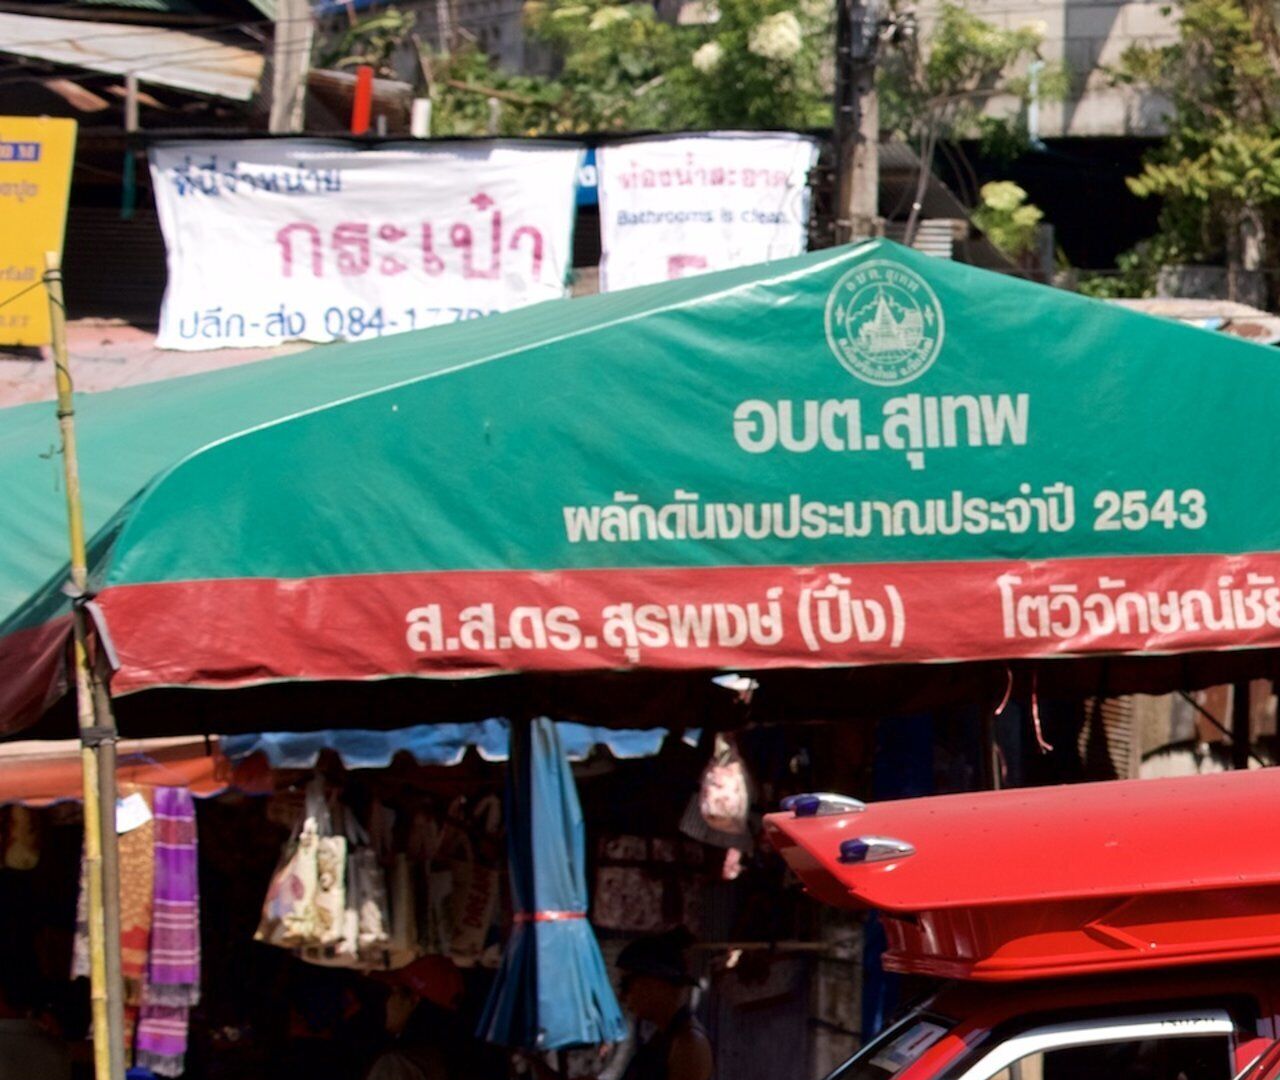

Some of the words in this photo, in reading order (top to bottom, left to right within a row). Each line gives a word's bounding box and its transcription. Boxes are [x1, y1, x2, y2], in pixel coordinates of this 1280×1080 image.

[276, 192, 545, 282] กระเป๋า
[617, 209, 712, 226] Bathrooms
[734, 393, 1029, 469] อบต.สุเทพ
[563, 484, 1074, 544] ผลักดันงบประมาณประจำปี
[1092, 488, 1208, 531] 2543
